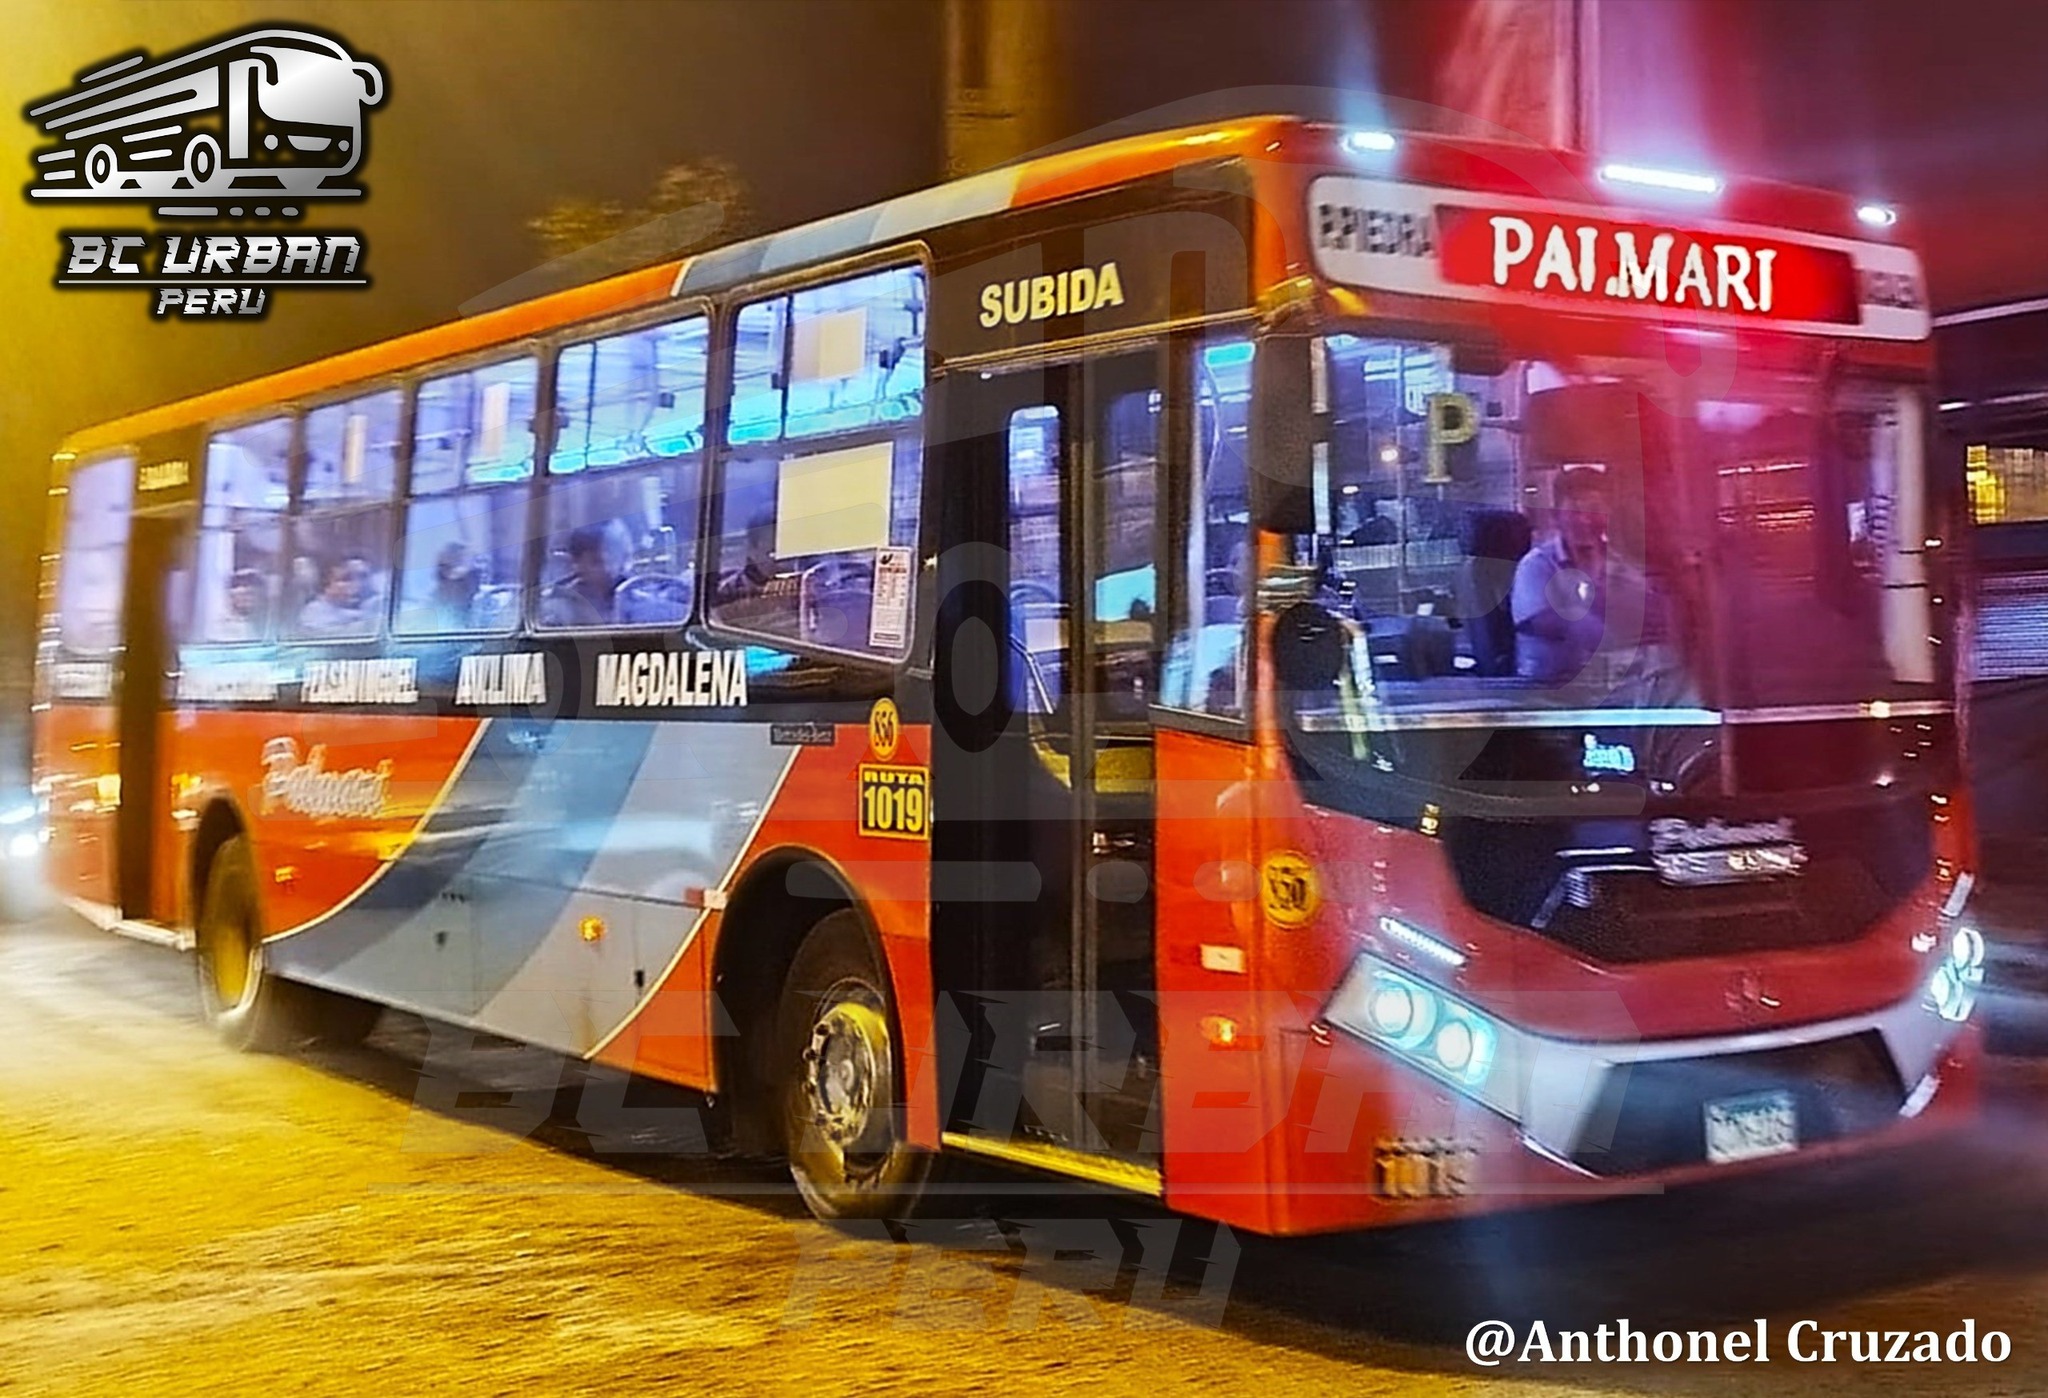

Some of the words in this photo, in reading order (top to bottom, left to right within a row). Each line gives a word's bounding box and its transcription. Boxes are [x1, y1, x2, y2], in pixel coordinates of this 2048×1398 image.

[979, 261, 1125, 328] SUBIDA
[1425, 392, 1480, 484] P
[595, 649, 749, 707] MAGDALENA
[864, 771, 925, 786] RUTA
[864, 785, 924, 832] 1019
